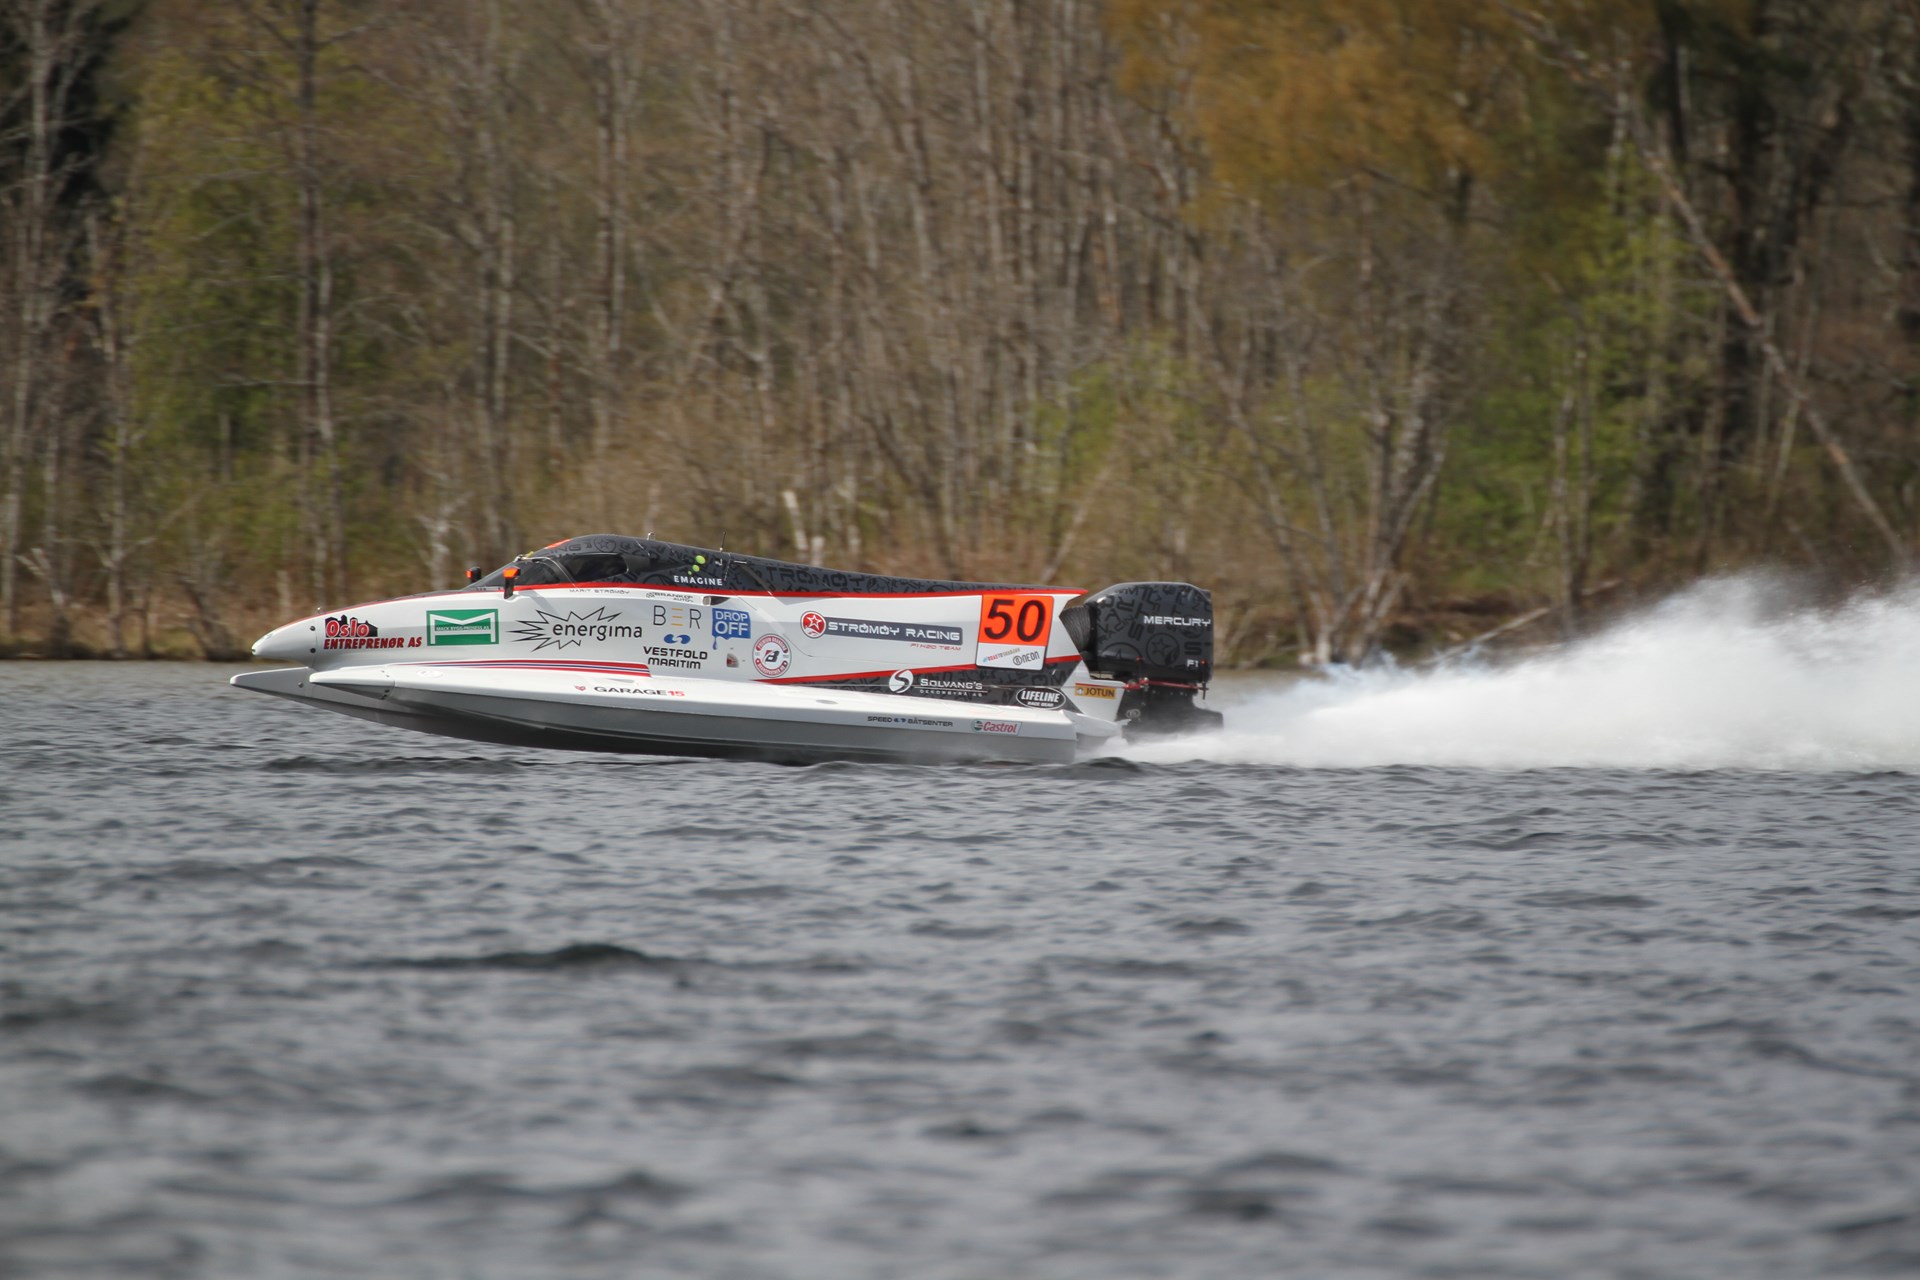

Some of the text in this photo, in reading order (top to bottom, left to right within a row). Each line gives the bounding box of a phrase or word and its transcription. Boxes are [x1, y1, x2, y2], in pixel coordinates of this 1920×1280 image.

[673, 575, 723, 586] EMAGINE
[653, 605, 702, 630] BER
[715, 610, 748, 622] DROP
[983, 598, 1046, 642] 50
[1143, 615, 1211, 627] MERCURY
[326, 618, 370, 637] Oslo
[552, 623, 643, 642] energima
[715, 621, 749, 636] OFF
[905, 628, 960, 641] RACING
[323, 637, 422, 650] ENTREPRENØR AS
[643, 646, 708, 660] VESTFOLD
[648, 658, 701, 670] MARITIM
[1186, 660, 1199, 668] F1
[920, 678, 983, 690] SOLVANG'S
[1021, 690, 1060, 703] LIFELINE
[1084, 688, 1115, 697] JOTUN
[908, 717, 954, 727] BÅTSENTER
[982, 721, 1018, 734] Castrol
